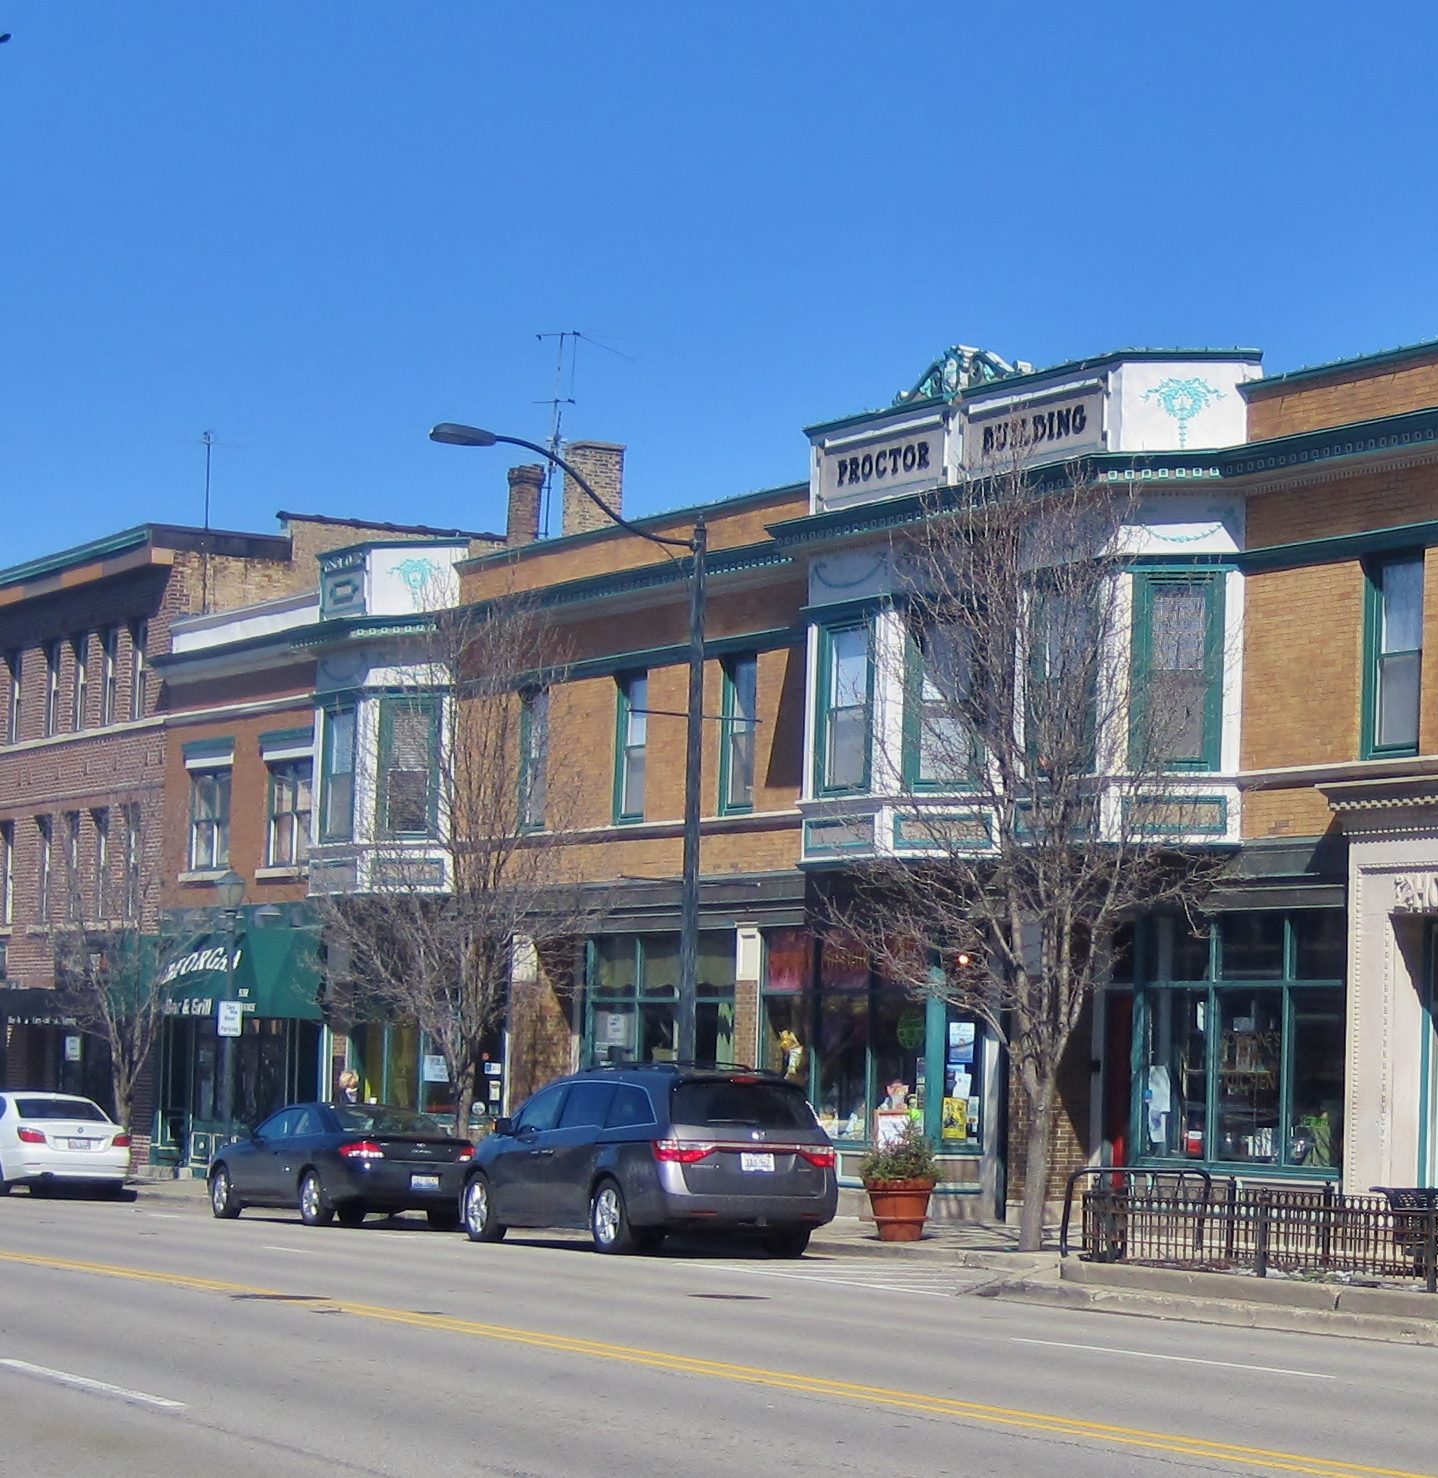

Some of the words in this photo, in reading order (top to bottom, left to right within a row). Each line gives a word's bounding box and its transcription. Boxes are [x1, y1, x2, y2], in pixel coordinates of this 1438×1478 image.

[836, 440, 931, 488] PROCTOR
[982, 404, 1088, 453] BUILDING
[182, 998, 190, 1015] &
[191, 997, 213, 1015] Grill
